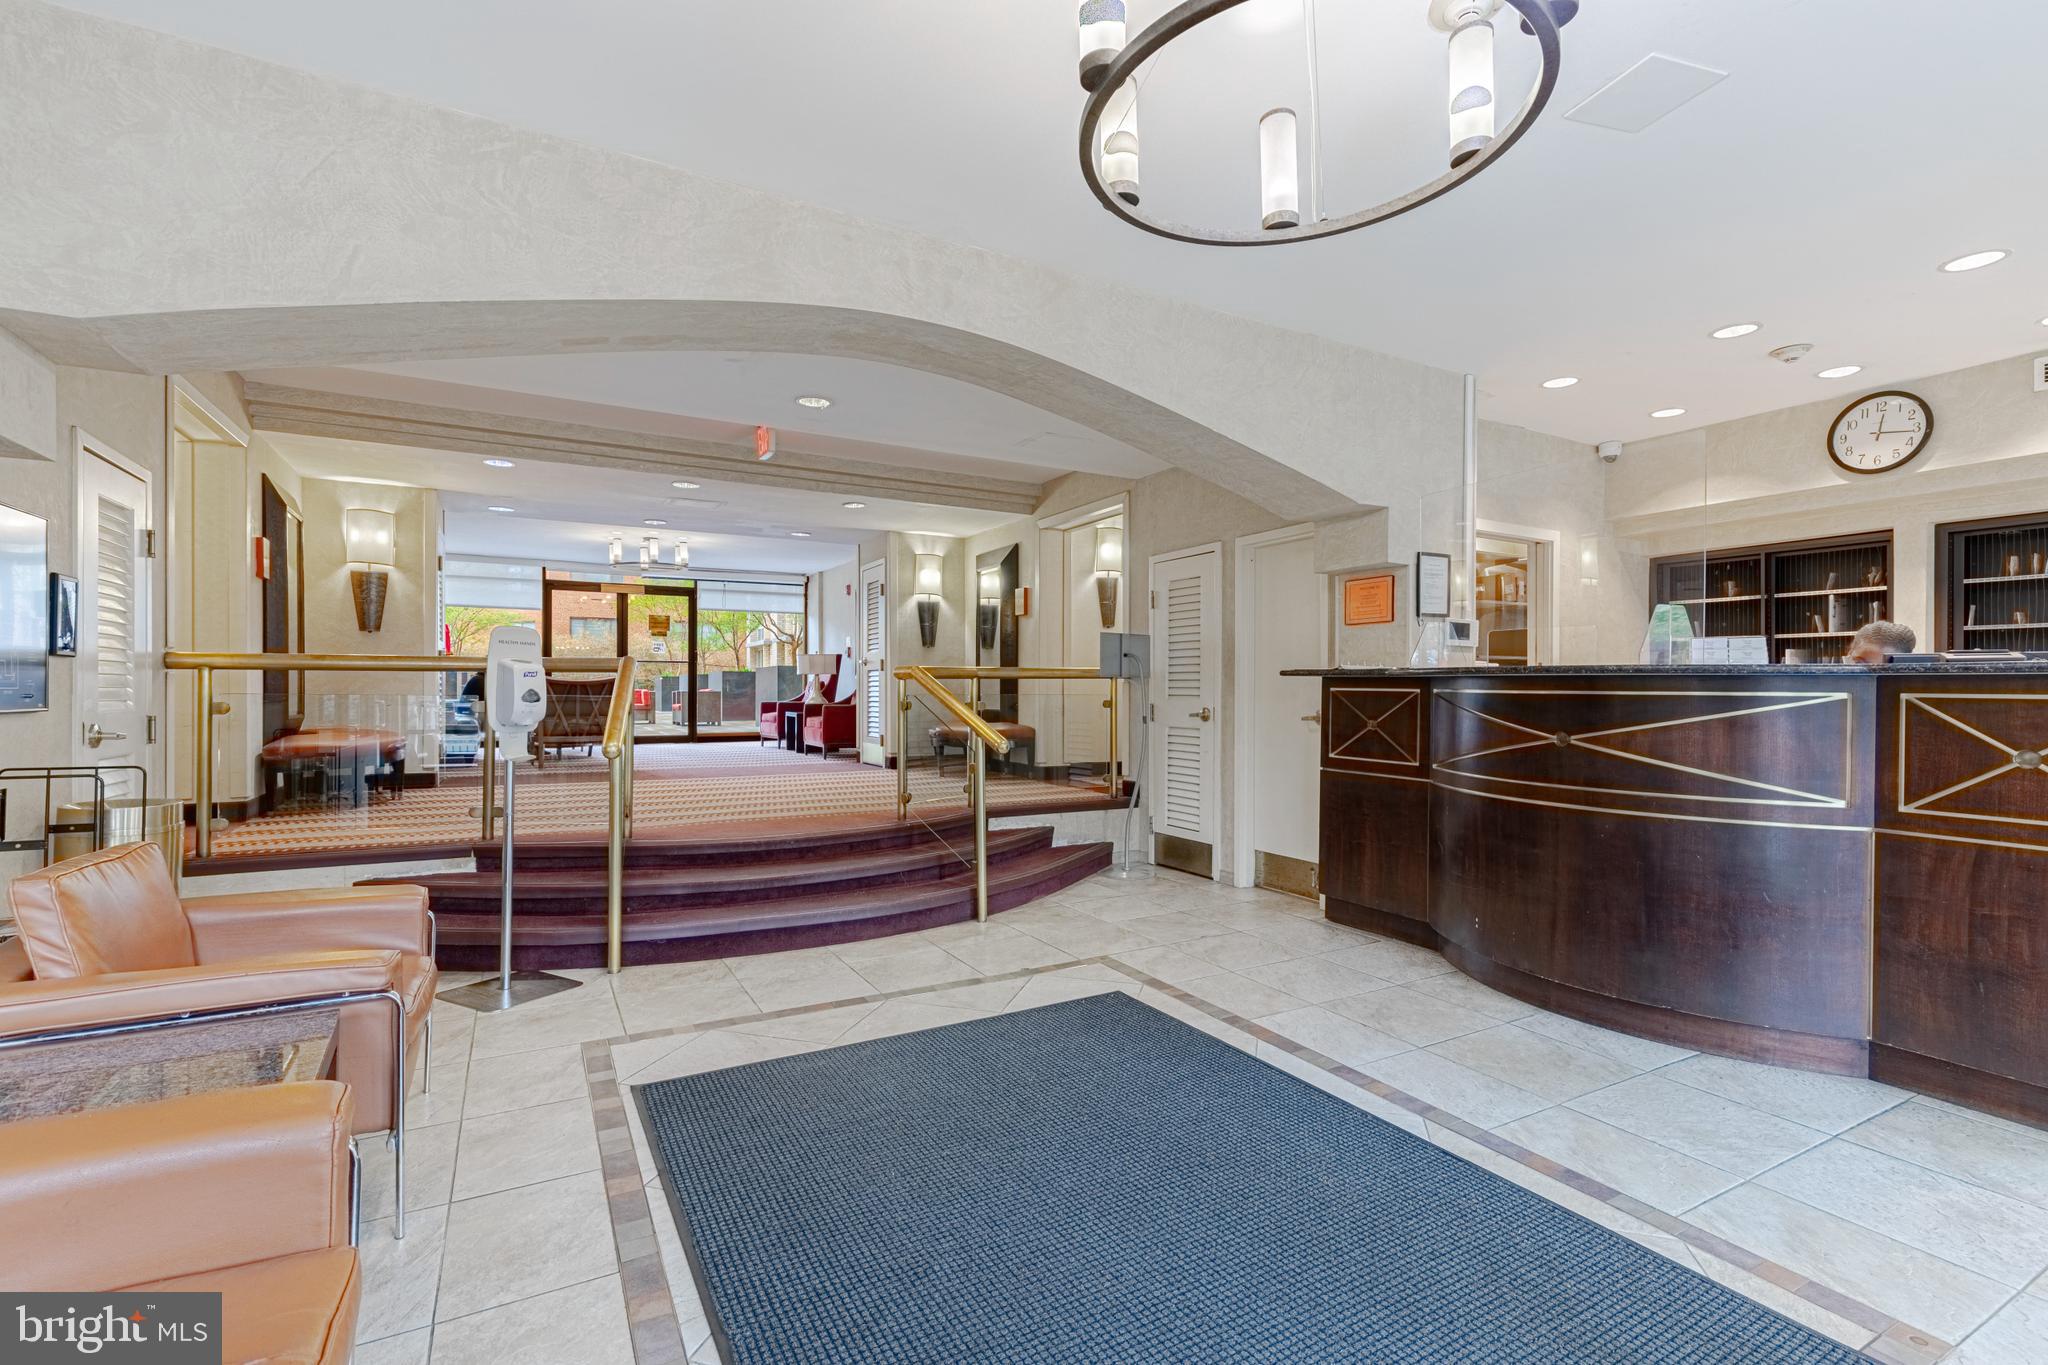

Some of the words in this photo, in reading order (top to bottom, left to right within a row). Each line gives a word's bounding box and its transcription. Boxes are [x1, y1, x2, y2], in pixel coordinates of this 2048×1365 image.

[1876, 401, 1888, 412] 12
[1899, 403, 1902, 413] 1
[1861, 408, 1869, 419] 11
[1908, 409, 1916, 420] 2
[1847, 420, 1858, 431] 10
[1913, 422, 1921, 432] 3
[1840, 434, 1847, 445] 9
[1905, 436, 1914, 447] 4
[1845, 446, 1853, 457] 8
[1892, 448, 1901, 458] 5
[1858, 454, 1866, 464] 7
[1873, 455, 1881, 465] 6
